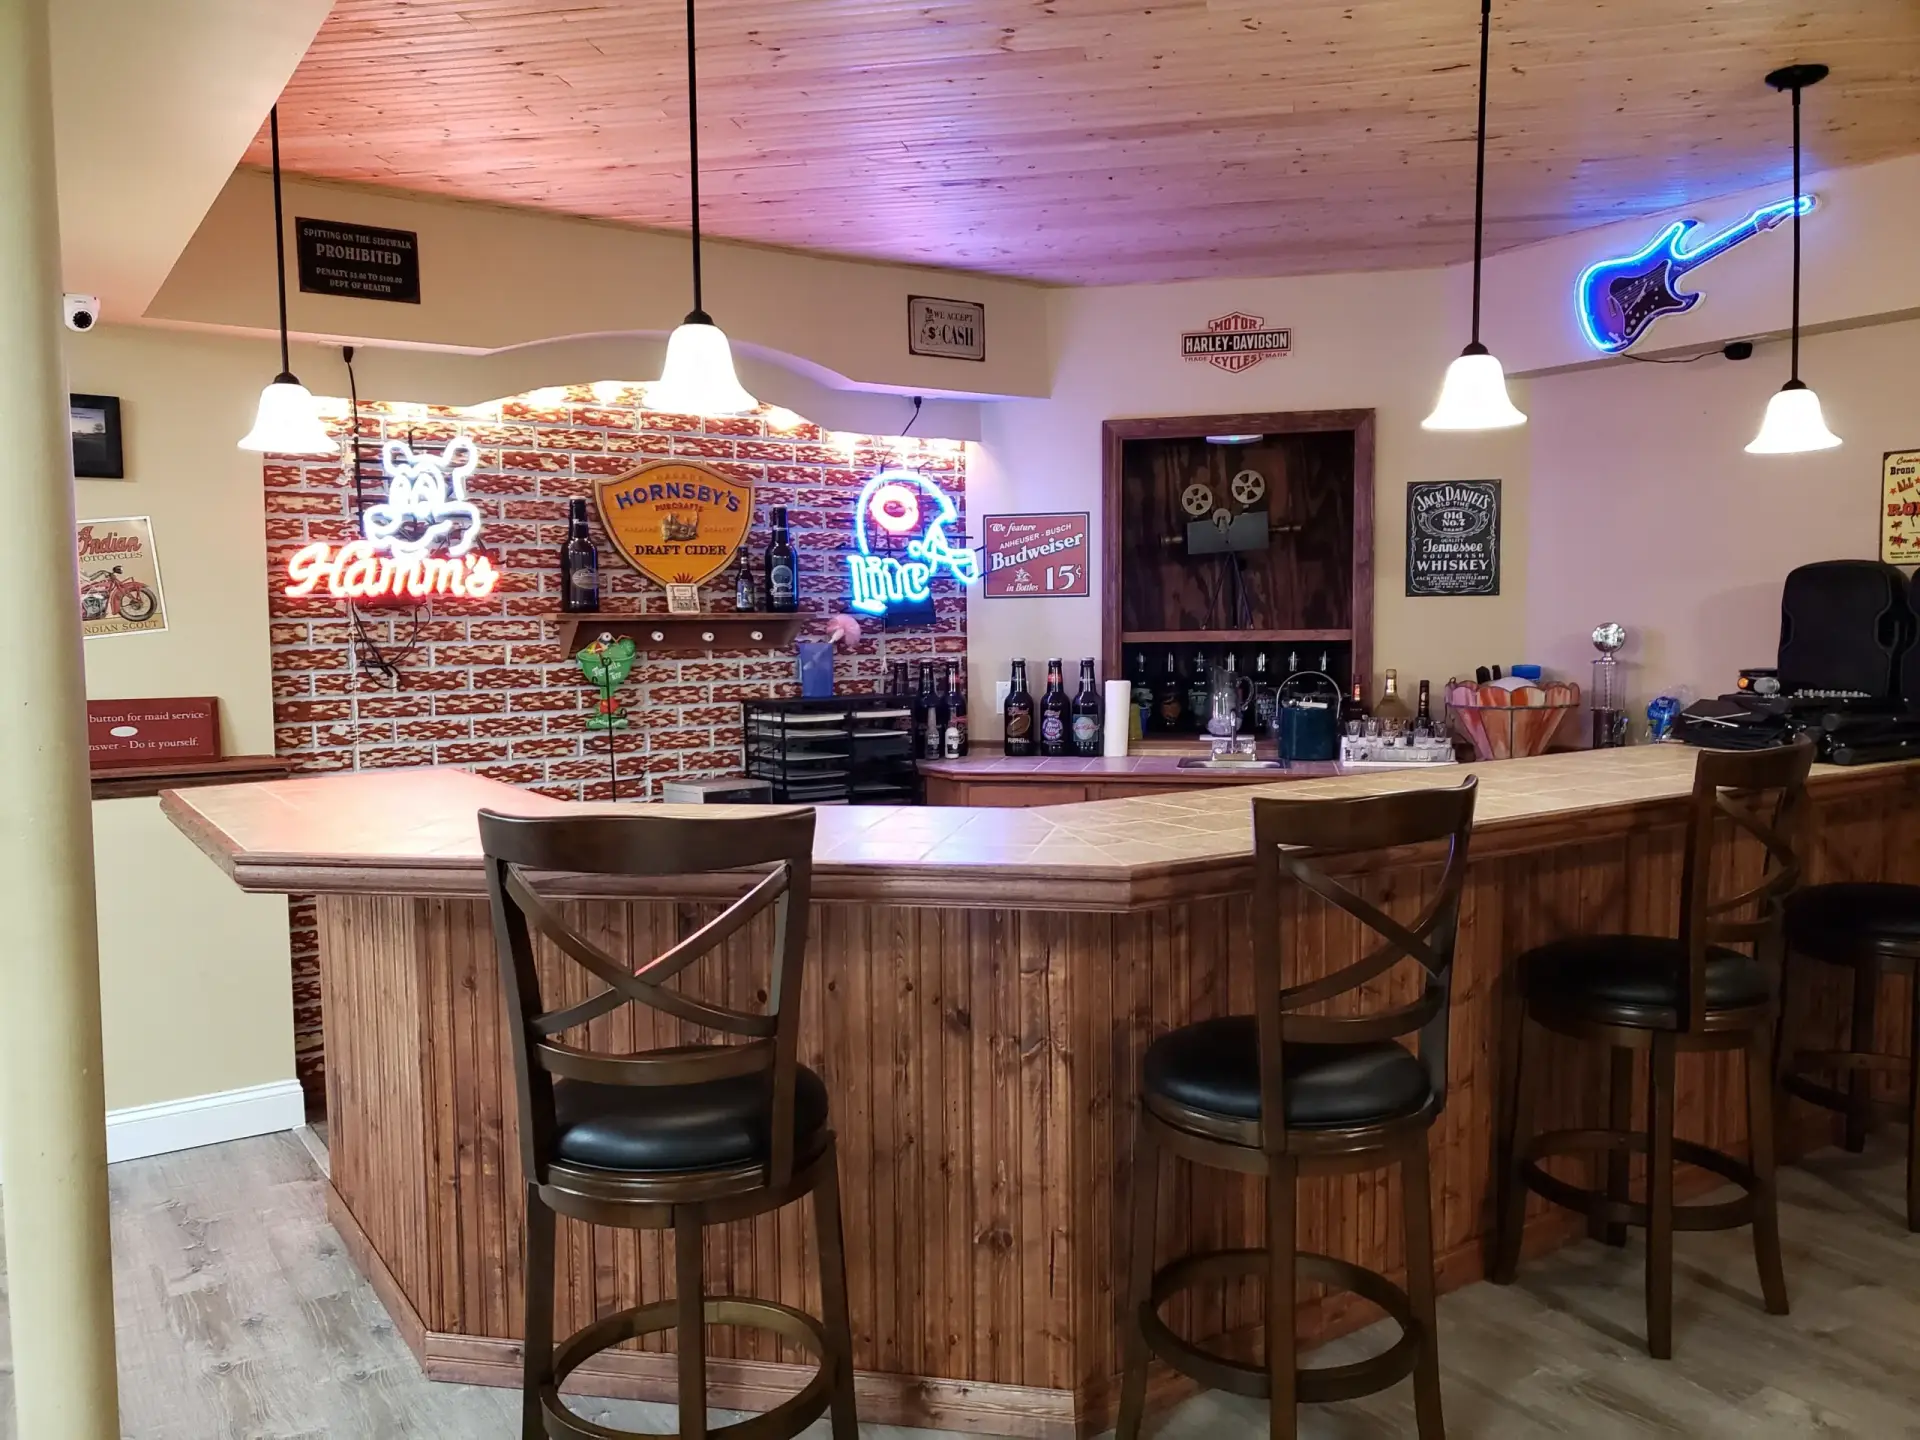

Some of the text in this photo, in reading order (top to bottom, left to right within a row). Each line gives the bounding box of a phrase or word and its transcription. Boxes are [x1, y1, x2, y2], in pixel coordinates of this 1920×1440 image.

[304, 228, 411, 249] SPITTING ON THE SIDEWALK
[316, 243, 402, 266] PROHIBITED
[316, 267, 348, 278] PENALTY
[368, 273, 378, 281] TO
[352, 281, 362, 290] OF
[363, 282, 391, 293] HEALTH
[934, 310, 973, 323] WE ACCEPT
[1214, 314, 1257, 331] MOTOR
[942, 324, 974, 346] CASH
[1185, 332, 1288, 352] HARLEY-DAVIDSON
[1214, 354, 1258, 370] CYCLES
[615, 482, 741, 512] HORNSBY'S
[1416, 486, 1490, 512] JACK DANIEL'S
[990, 522, 1036, 537] We feature
[78, 526, 142, 556] Indian
[1422, 538, 1483, 552] Tennessee
[634, 545, 728, 556] DRAFT CIDER
[991, 534, 1084, 572] Budweiser
[285, 540, 499, 598] Hamm's
[1416, 560, 1490, 571] WHISKEY
[1006, 582, 1039, 592] in Bottles
[84, 620, 158, 634] NDIAN SCOUT
[89, 714, 124, 723] button
[127, 712, 141, 722] for
[144, 712, 168, 720] maid
[89, 743, 118, 751] nswer
[130, 740, 145, 749] Do
[148, 740, 156, 748] it
[158, 738, 199, 750] yourself.
